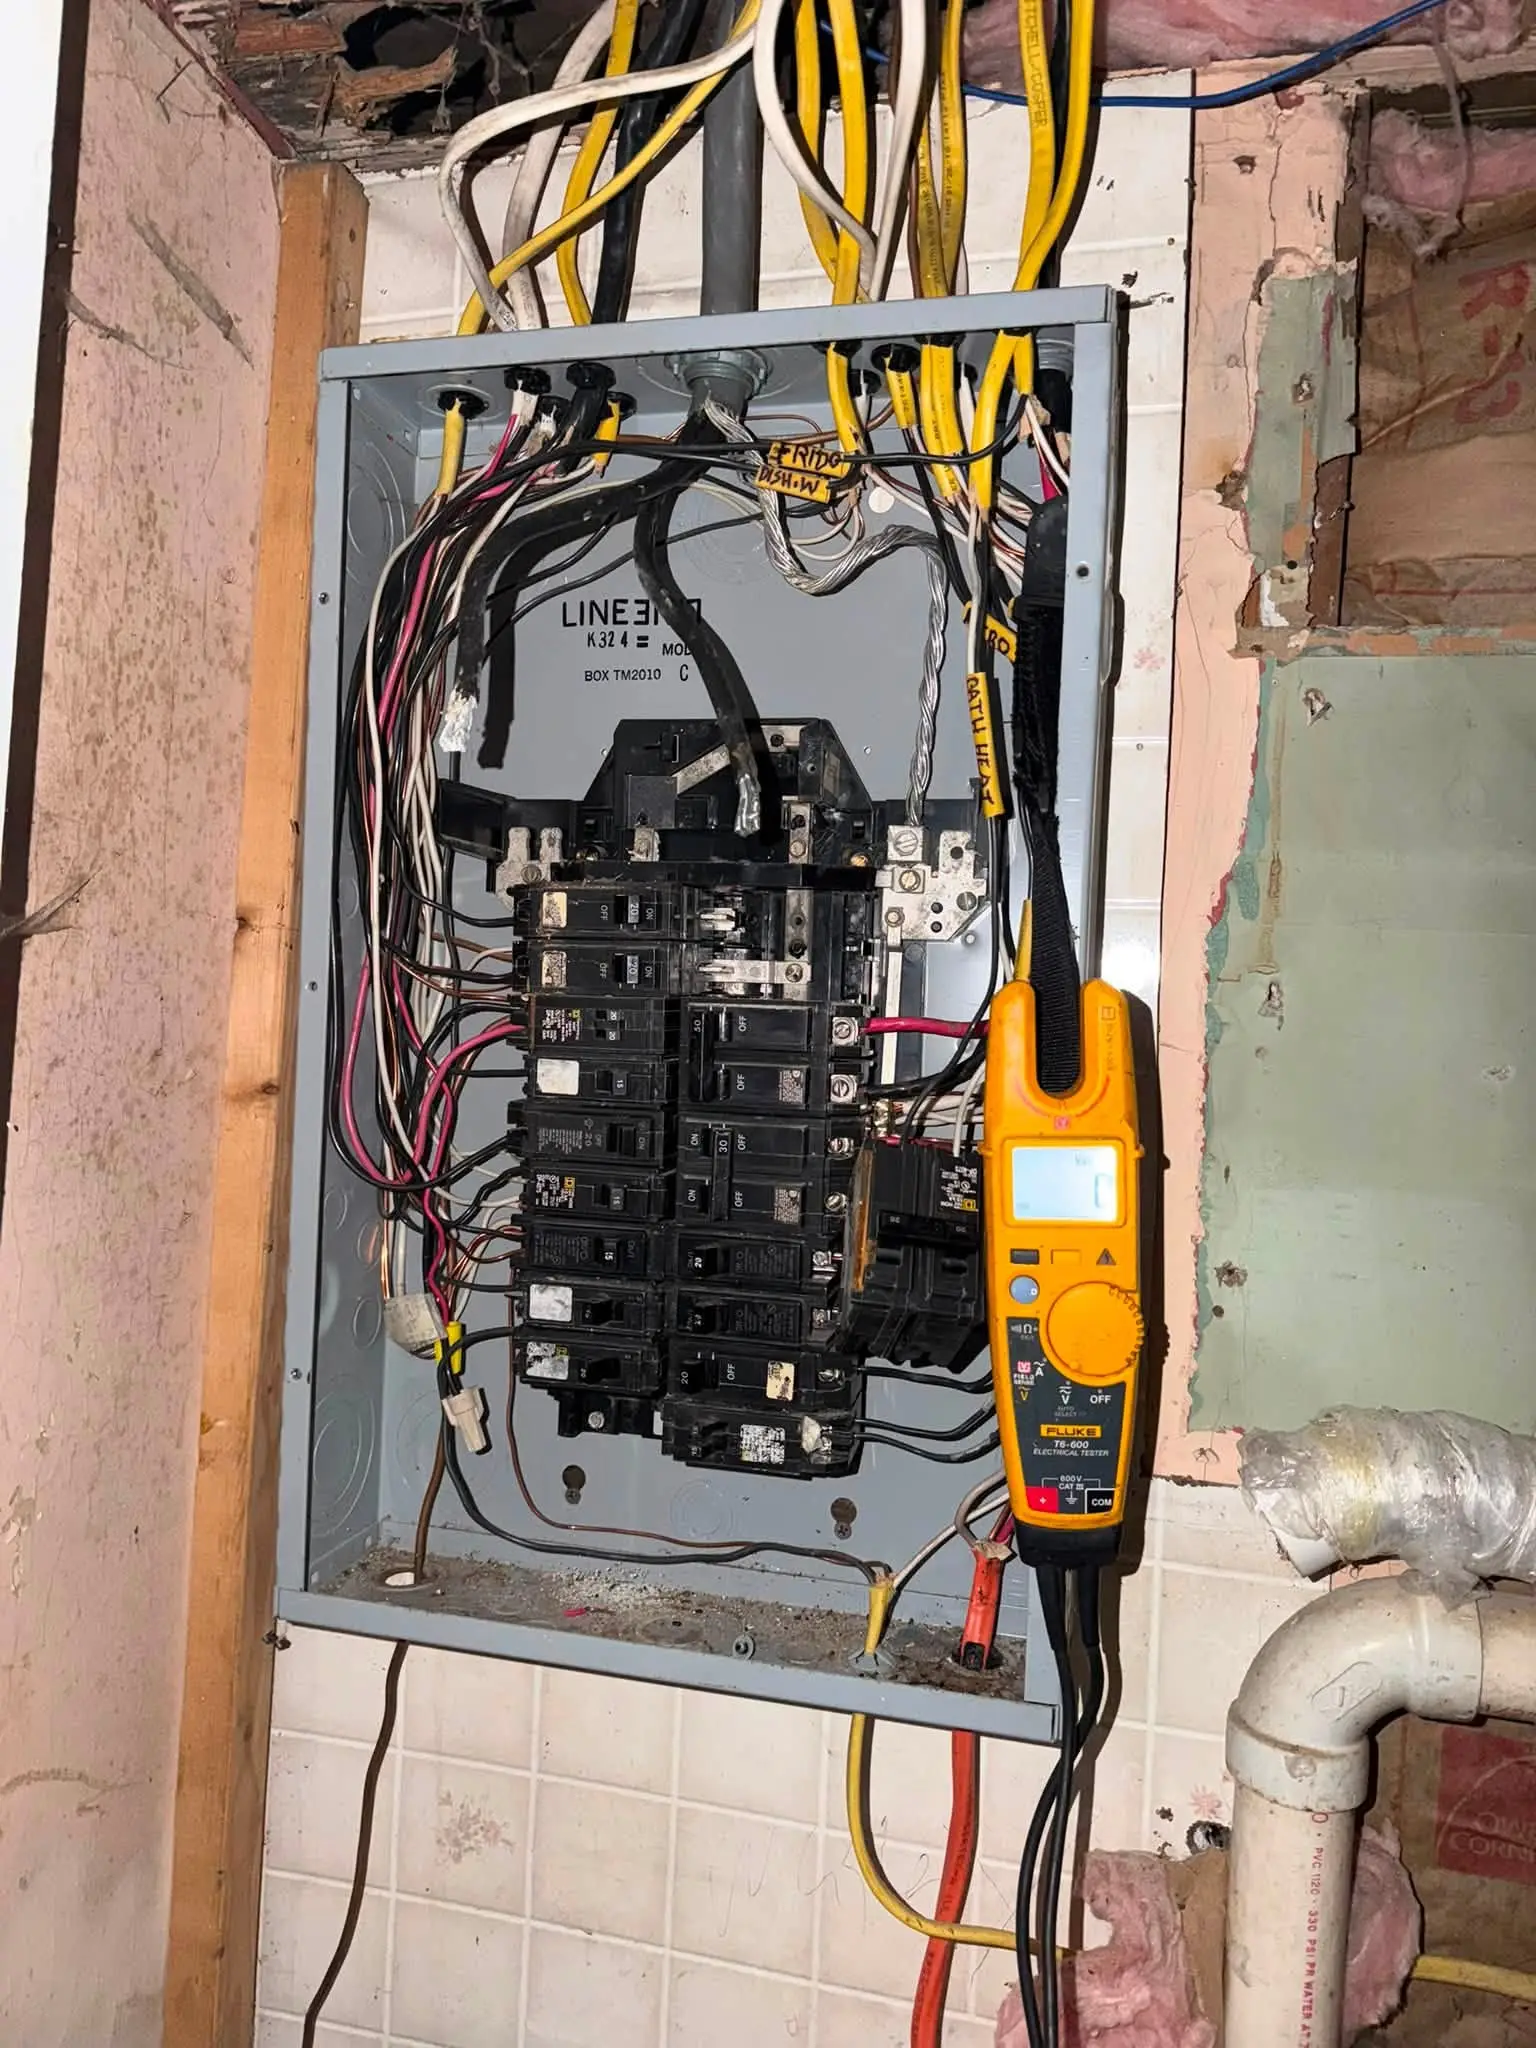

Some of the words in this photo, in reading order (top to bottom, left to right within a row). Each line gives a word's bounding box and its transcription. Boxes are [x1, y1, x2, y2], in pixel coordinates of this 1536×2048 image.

[584, 670, 609, 682] BOX
[614, 668, 662, 681] TM2010
[679, 664, 690, 682] C
[600, 904, 609, 921] OFF
[645, 907, 654, 921] ON
[599, 962, 608, 979] OFF
[644, 965, 653, 979] ON
[738, 1015, 748, 1033] OFF
[736, 1073, 745, 1091] OFF
[638, 1137, 646, 1151] ON
[690, 1133, 700, 1146] ON
[718, 1139, 728, 1153] 30
[737, 1134, 747, 1151] OFF
[687, 1189, 697, 1202] ON
[734, 1191, 744, 1208] OFF
[680, 1371, 690, 1385] 20
[727, 1363, 736, 1381] OFF
[1061, 1395, 1071, 1405] V
[1089, 1395, 1112, 1405] OFF
[1046, 1427, 1097, 1436] FLUKE
[1032, 1448, 1078, 1457] ELECTRICAL
[1080, 1449, 1110, 1457] TESTER
[1053, 1440, 1090, 1449] T6-600
[1091, 1498, 1113, 1507] COM
[1312, 1847, 1325, 1868] PVC
[1310, 1871, 1322, 1896] 1120
[1307, 1909, 1319, 1933] 330
[1306, 1939, 1318, 1957] PSI
[1304, 1962, 1316, 1978] PR
[1301, 1981, 1315, 2022] WATER
[1300, 2024, 1312, 2040] AT
